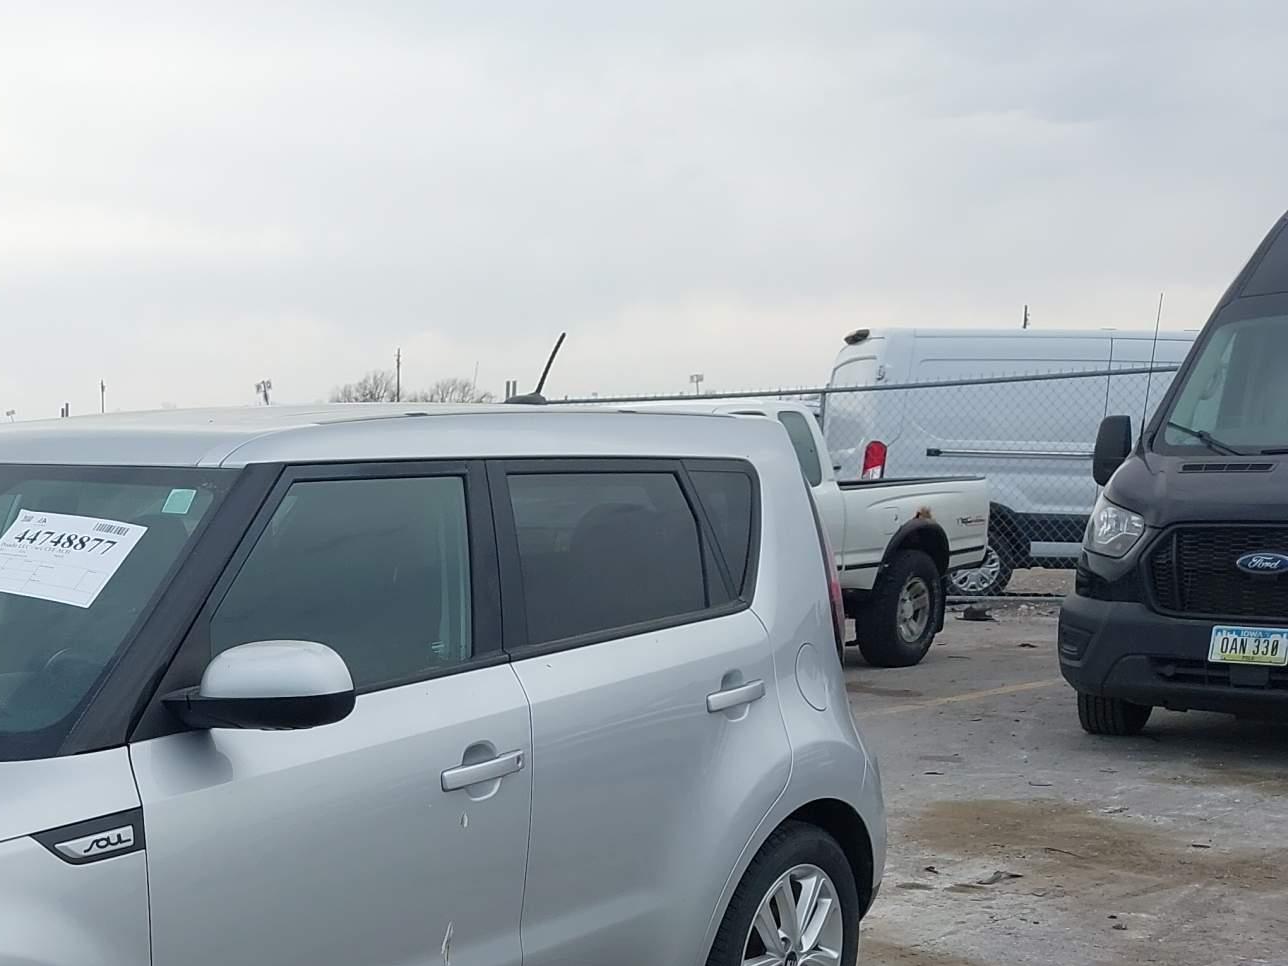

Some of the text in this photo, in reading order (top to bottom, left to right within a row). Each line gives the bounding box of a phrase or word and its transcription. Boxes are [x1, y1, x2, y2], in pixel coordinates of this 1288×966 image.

[14, 529, 118, 555] 44748877
[1247, 555, 1282, 569] Ford
[1252, 639, 1280, 657] 330
[83, 833, 131, 853] SOUL
